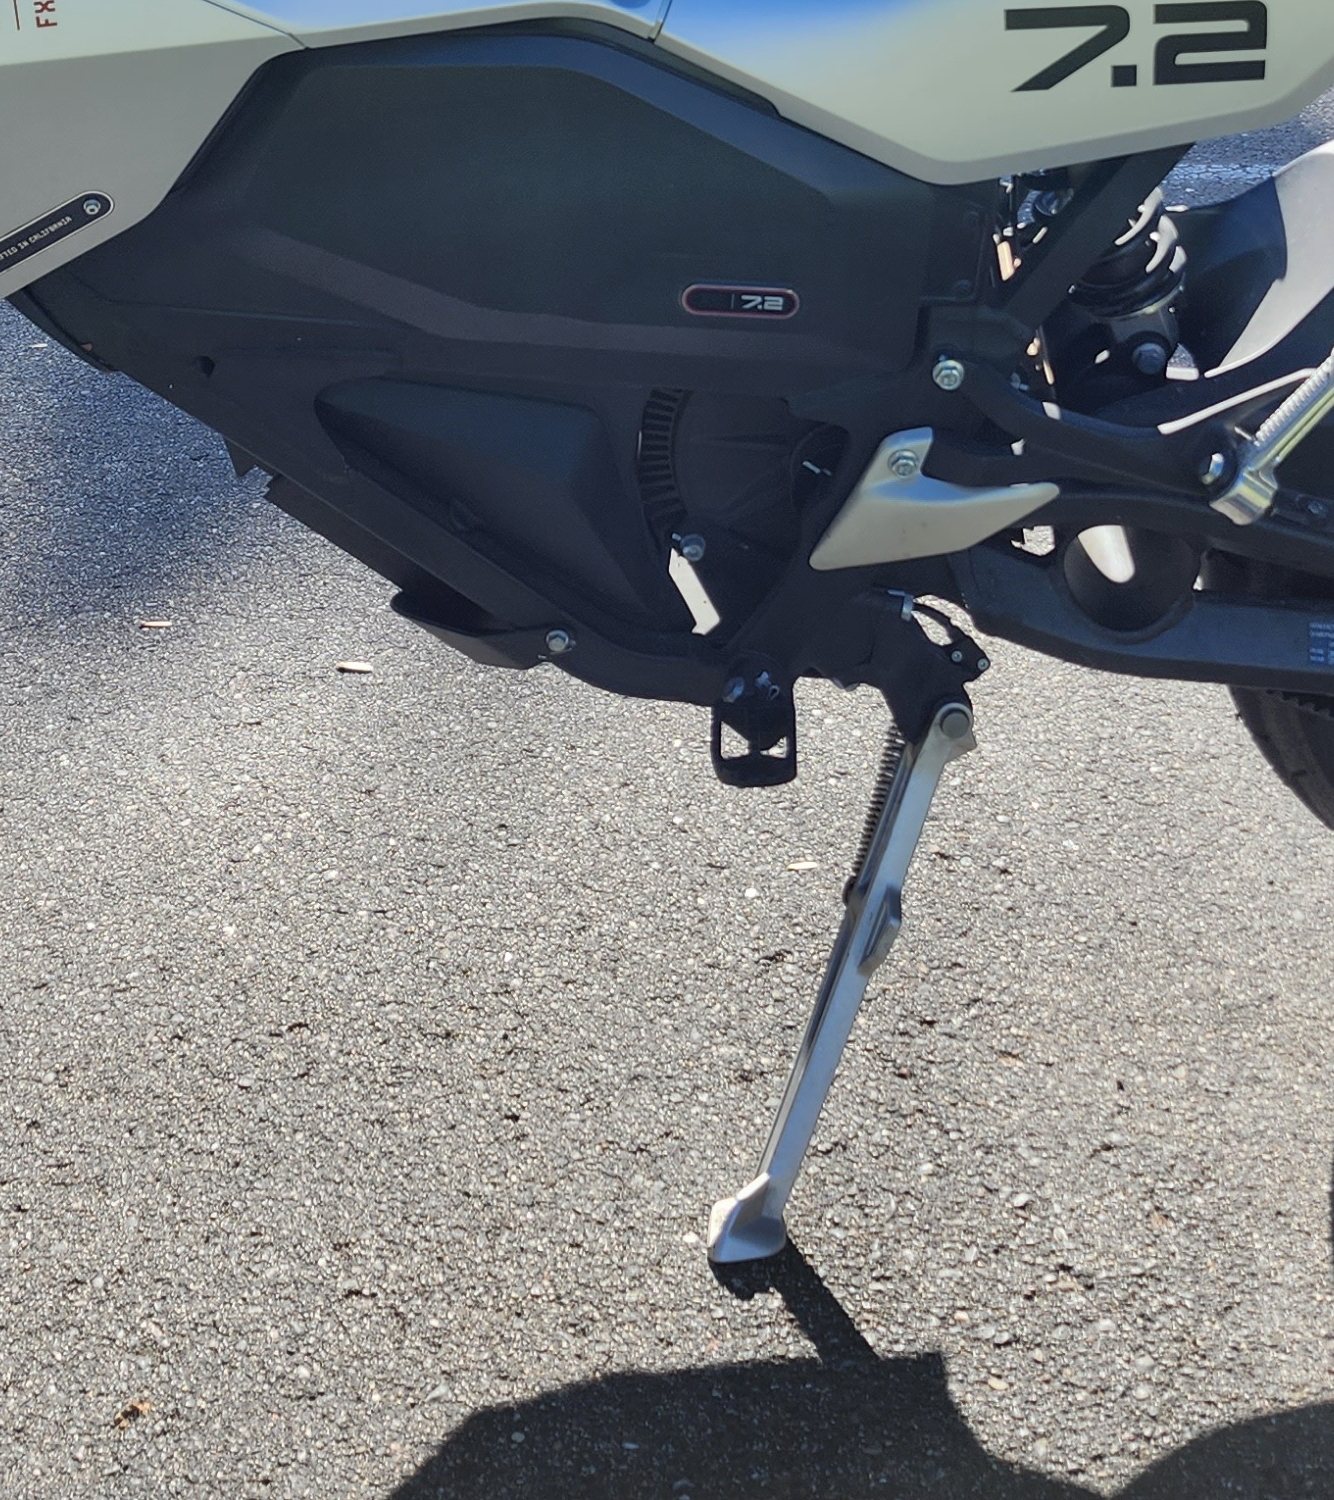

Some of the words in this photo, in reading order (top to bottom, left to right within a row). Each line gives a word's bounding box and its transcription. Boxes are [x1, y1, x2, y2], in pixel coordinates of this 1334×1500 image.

[1004, 0, 1267, 92] 7.2
[17, 240, 29, 250] IN
[28, 215, 72, 243] CALIFORNIA
[741, 294, 784, 311] 7.2
